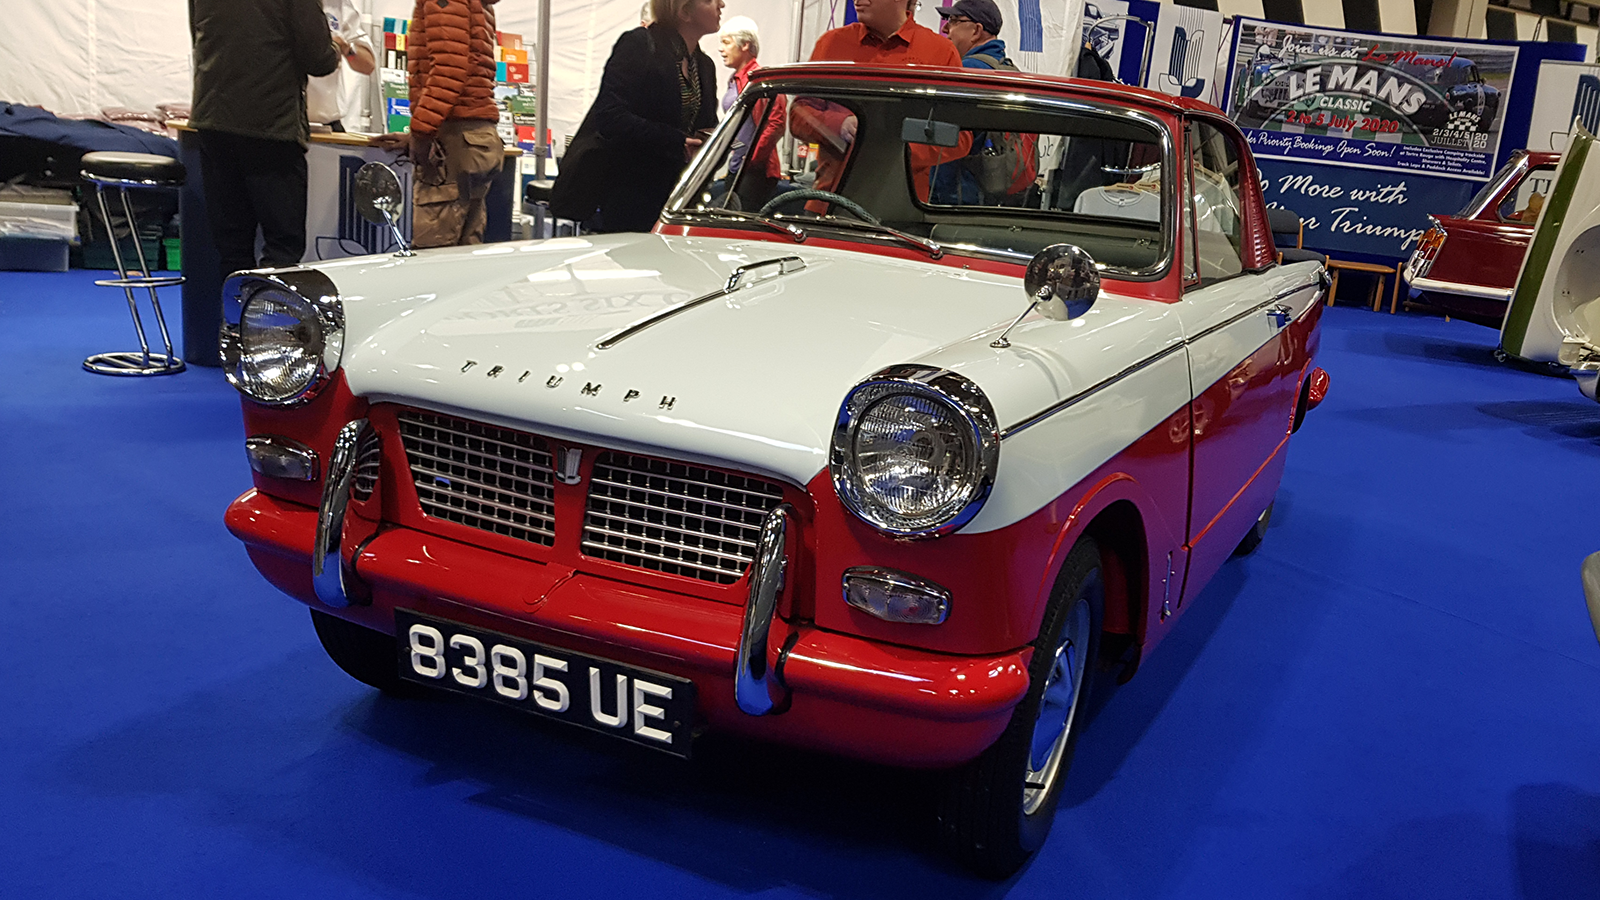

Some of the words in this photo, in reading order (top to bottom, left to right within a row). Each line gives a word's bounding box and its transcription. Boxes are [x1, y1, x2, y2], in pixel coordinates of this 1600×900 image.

[1279, 34, 1315, 58] Join
[1319, 46, 1338, 57] us
[1340, 46, 1368, 58] at
[1362, 43, 1388, 62] Le
[1393, 50, 1459, 68] Mans!
[1289, 66, 1322, 100] LE
[1327, 65, 1427, 115] MANS
[1320, 96, 1373, 112] CLASSIC
[1449, 111, 1458, 120] LE
[1458, 110, 1481, 123] MANS
[1286, 110, 1297, 123] 2
[1298, 113, 1312, 124] to
[1315, 114, 1326, 126] 5
[1327, 115, 1357, 132] July
[1360, 118, 1399, 133] 2020
[1258, 131, 1293, 154] Priority
[1293, 136, 1335, 156] Bookings
[1337, 140, 1361, 158] Open
[1363, 143, 1397, 158] Soon!
[1430, 136, 1470, 147] JUILLET
[1472, 140, 1487, 149] 20
[1432, 128, 1470, 139] 2/3/4/5
[1474, 132, 1489, 141] 20
[1278, 174, 1344, 198] More
[1349, 181, 1408, 205] with
[1330, 207, 1424, 251] Triump
[460, 359, 677, 412] TRIUMPH
[408, 622, 570, 714] 8385
[588, 665, 675, 745] UE
